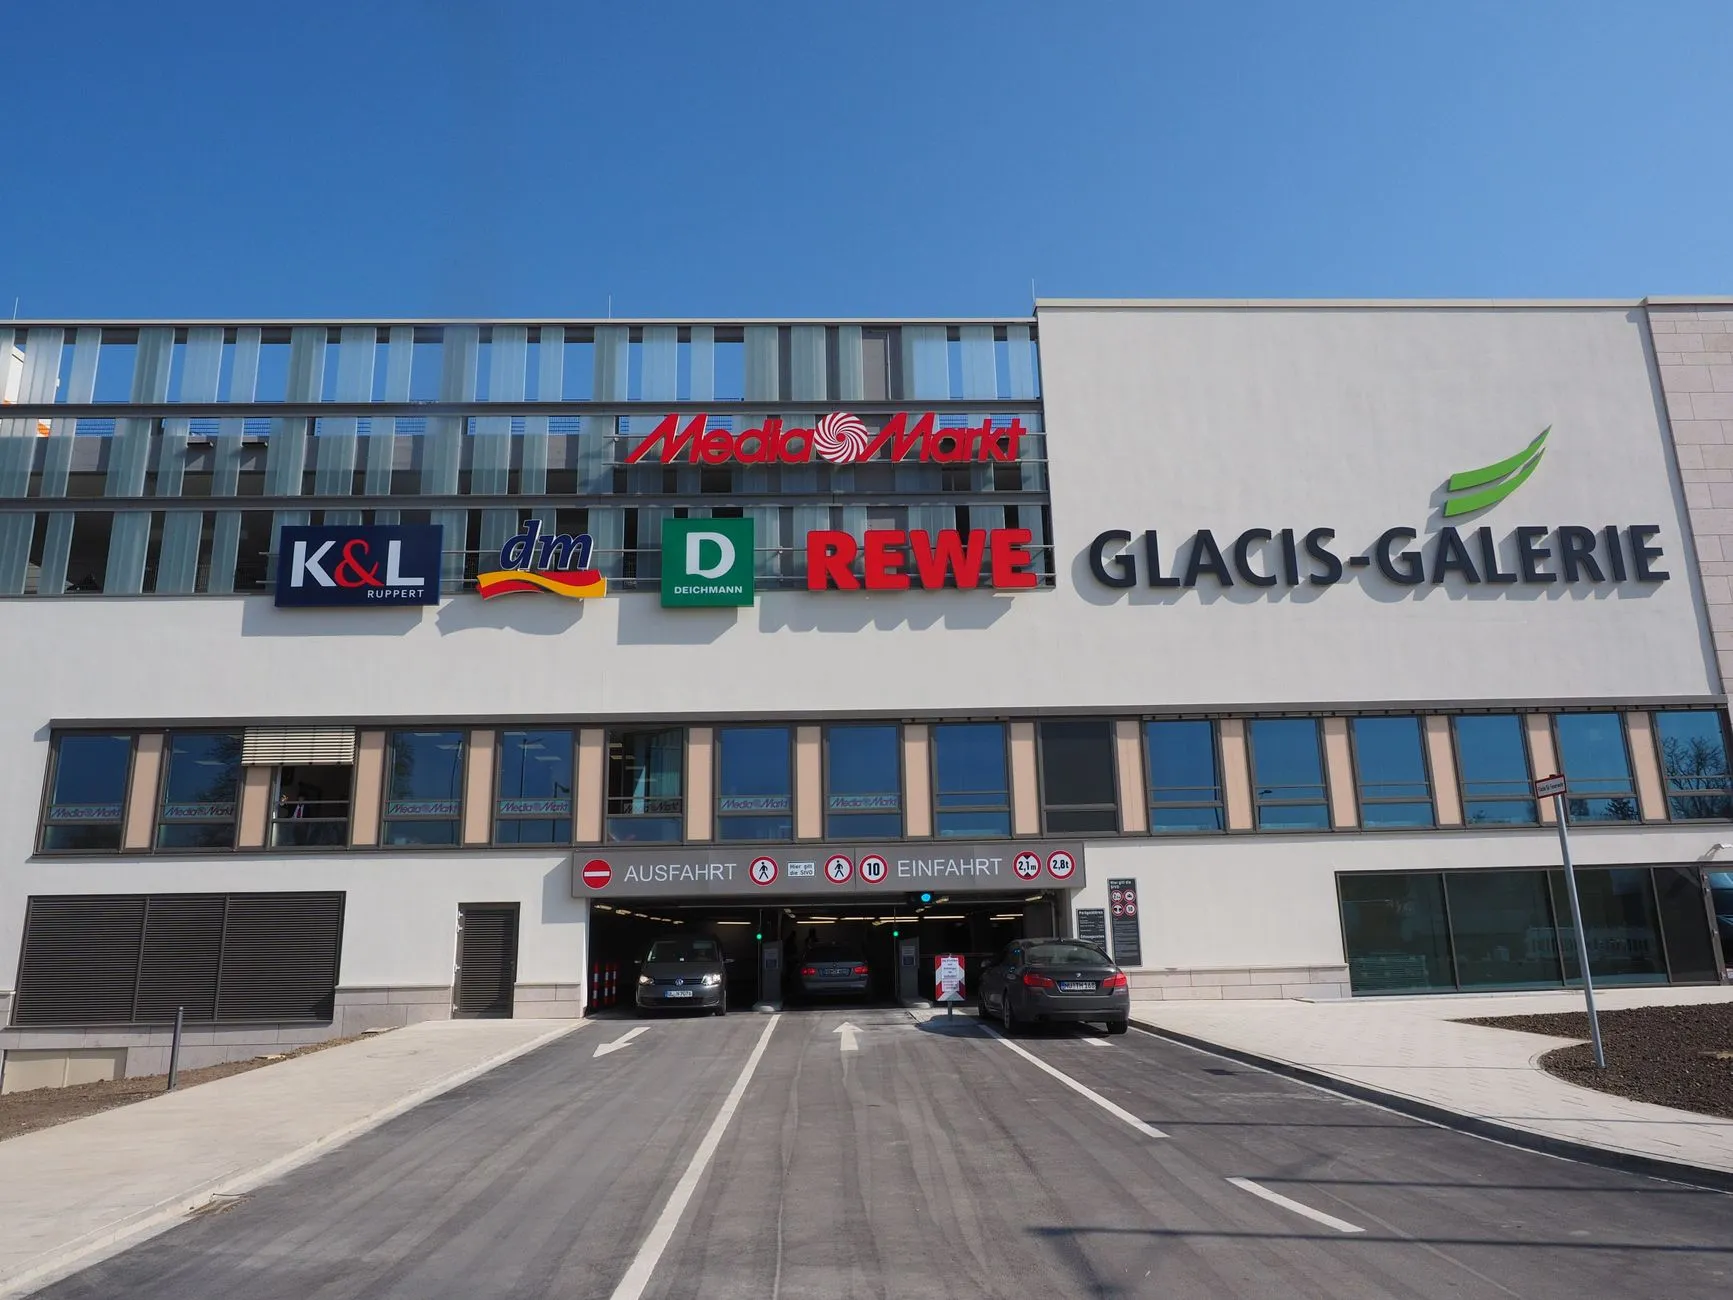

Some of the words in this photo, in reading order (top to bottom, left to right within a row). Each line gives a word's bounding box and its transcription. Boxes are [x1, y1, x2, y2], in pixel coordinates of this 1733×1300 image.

[624, 413, 814, 465] Media
[855, 412, 1027, 463] Markt
[290, 538, 425, 588] K&L
[500, 519, 594, 571] dm
[685, 531, 736, 579] D
[806, 528, 1038, 591] REWE
[1088, 524, 1671, 588] GLACIS-GALERIE
[367, 589, 425, 599] RUPPERT
[674, 585, 743, 595] DEICHMANN
[624, 863, 737, 882] AUSFAHRT
[866, 862, 880, 876] 10
[897, 858, 1003, 877] EINFAHRT
